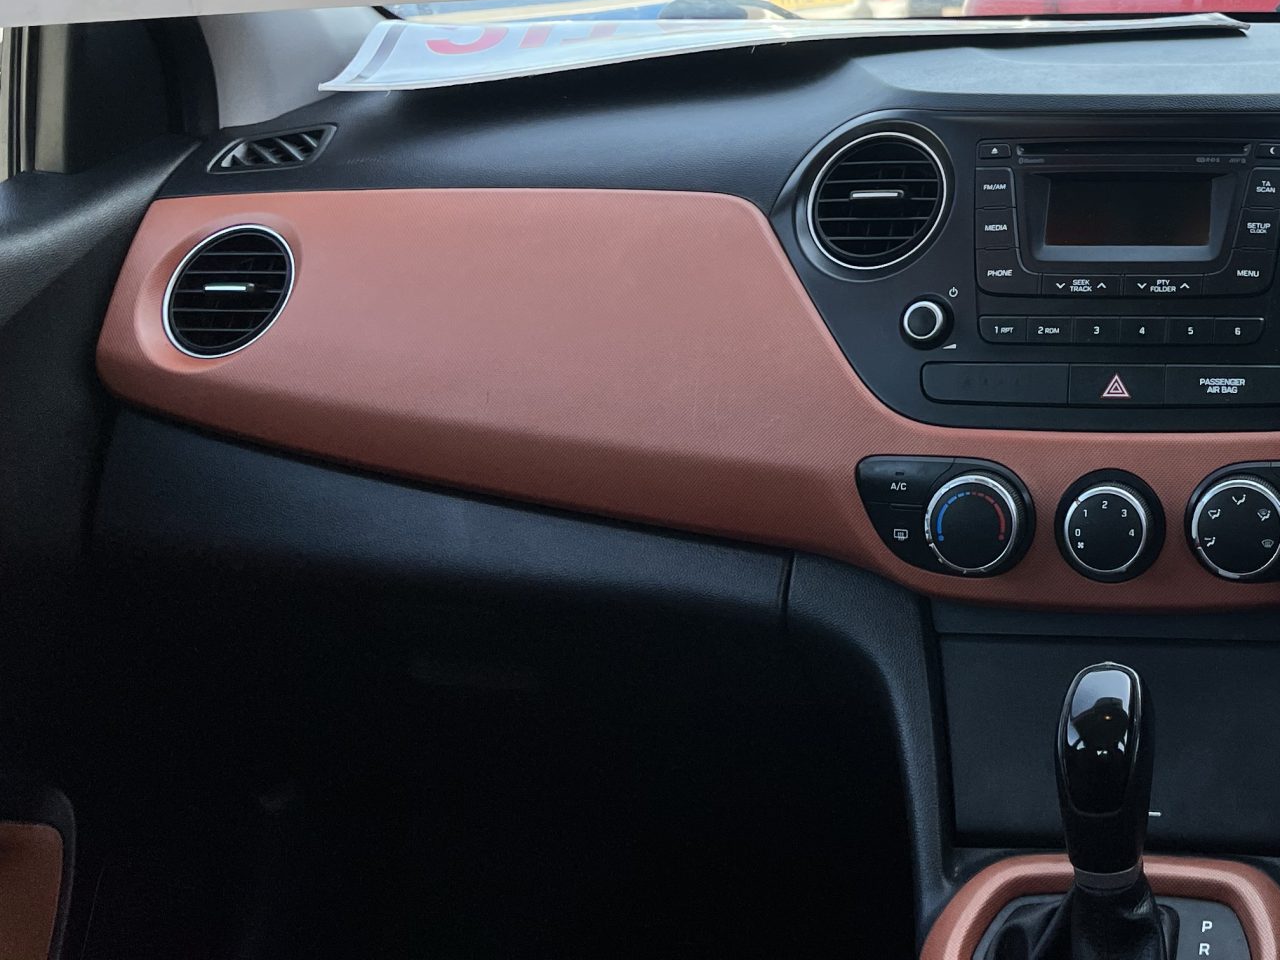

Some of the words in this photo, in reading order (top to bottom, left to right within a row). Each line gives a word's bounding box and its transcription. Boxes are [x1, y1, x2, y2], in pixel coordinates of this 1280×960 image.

[984, 183, 1007, 191] FM/AM
[984, 224, 1008, 232] MEDIA
[987, 269, 1013, 277] PHONE
[1237, 269, 1260, 277] MENU
[994, 326, 999, 334] 1
[1000, 326, 1014, 334] RPT
[1037, 326, 1044, 334] 2
[1044, 326, 1060, 334] RDM
[1093, 326, 1100, 335] 3
[1138, 326, 1145, 335] 4
[1187, 326, 1194, 335] 5
[1235, 327, 1241, 336] 6
[1199, 378, 1246, 386] PASSENGER
[1206, 386, 1220, 394] AIR
[1221, 386, 1238, 394] BAG
[890, 482, 907, 491] A/C
[1101, 501, 1108, 509] 2
[1083, 509, 1088, 517] 1
[1121, 509, 1127, 517] 3
[1074, 528, 1081, 537] 0
[1128, 528, 1135, 536] 4
[1201, 920, 1213, 933] P
[1198, 943, 1210, 956] R
